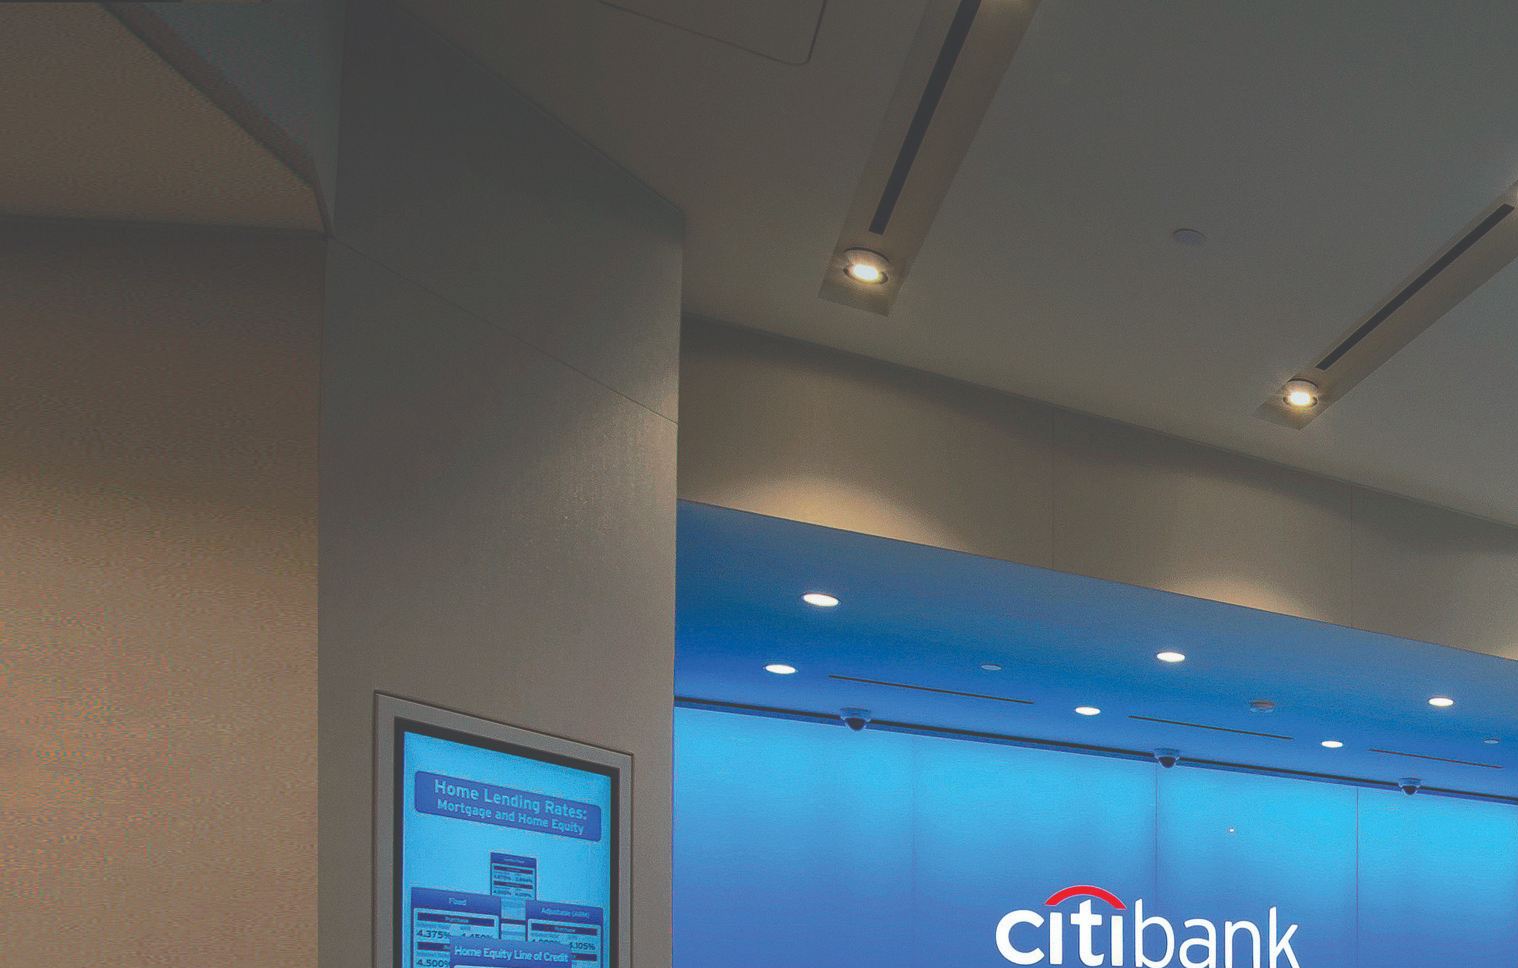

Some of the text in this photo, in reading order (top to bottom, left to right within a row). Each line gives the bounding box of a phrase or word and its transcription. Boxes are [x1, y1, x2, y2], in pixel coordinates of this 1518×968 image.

[434, 779, 587, 820] Home Lending Rates:
[437, 798, 584, 835] Mortgage and Home Equity
[454, 945, 482, 957] Home
[483, 947, 513, 960] Equity
[514, 950, 533, 960] Line
[543, 951, 569, 962] Credit
